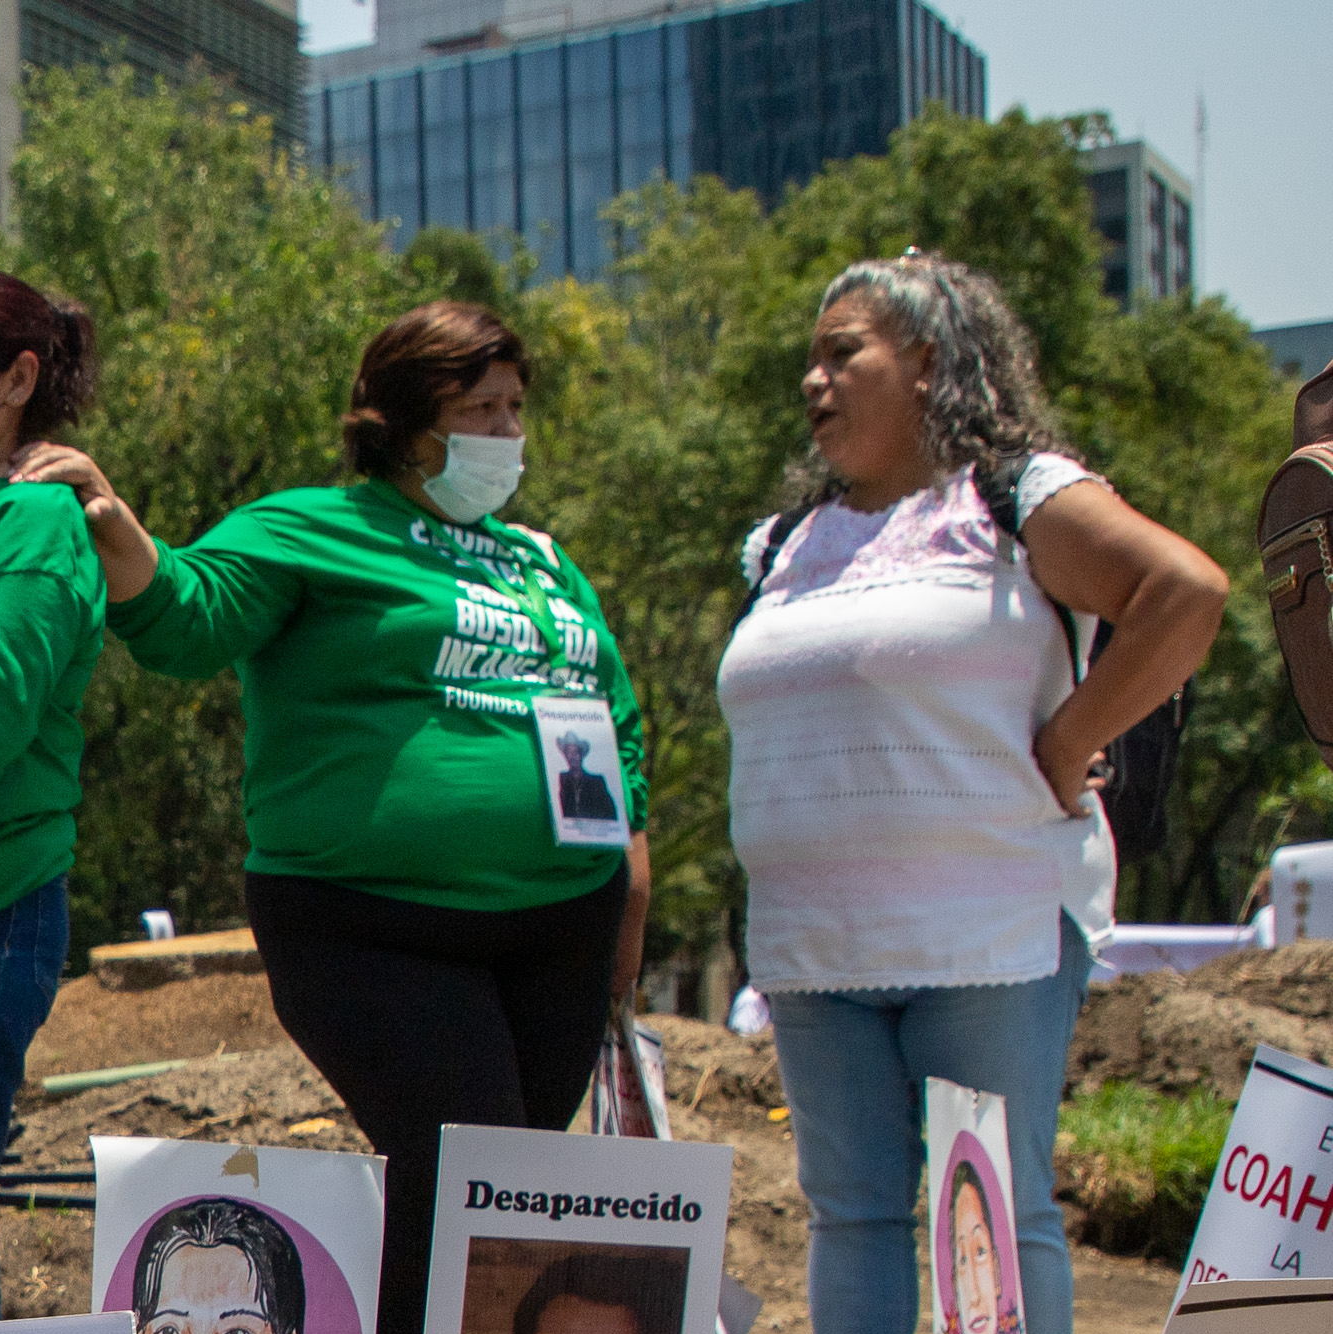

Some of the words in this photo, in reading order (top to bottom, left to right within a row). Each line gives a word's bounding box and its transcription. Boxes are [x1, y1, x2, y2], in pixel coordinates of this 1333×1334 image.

[464, 1179, 703, 1223] Desaparecido
[1222, 1143, 1333, 1233] COAH
[1270, 1243, 1302, 1277] LA
